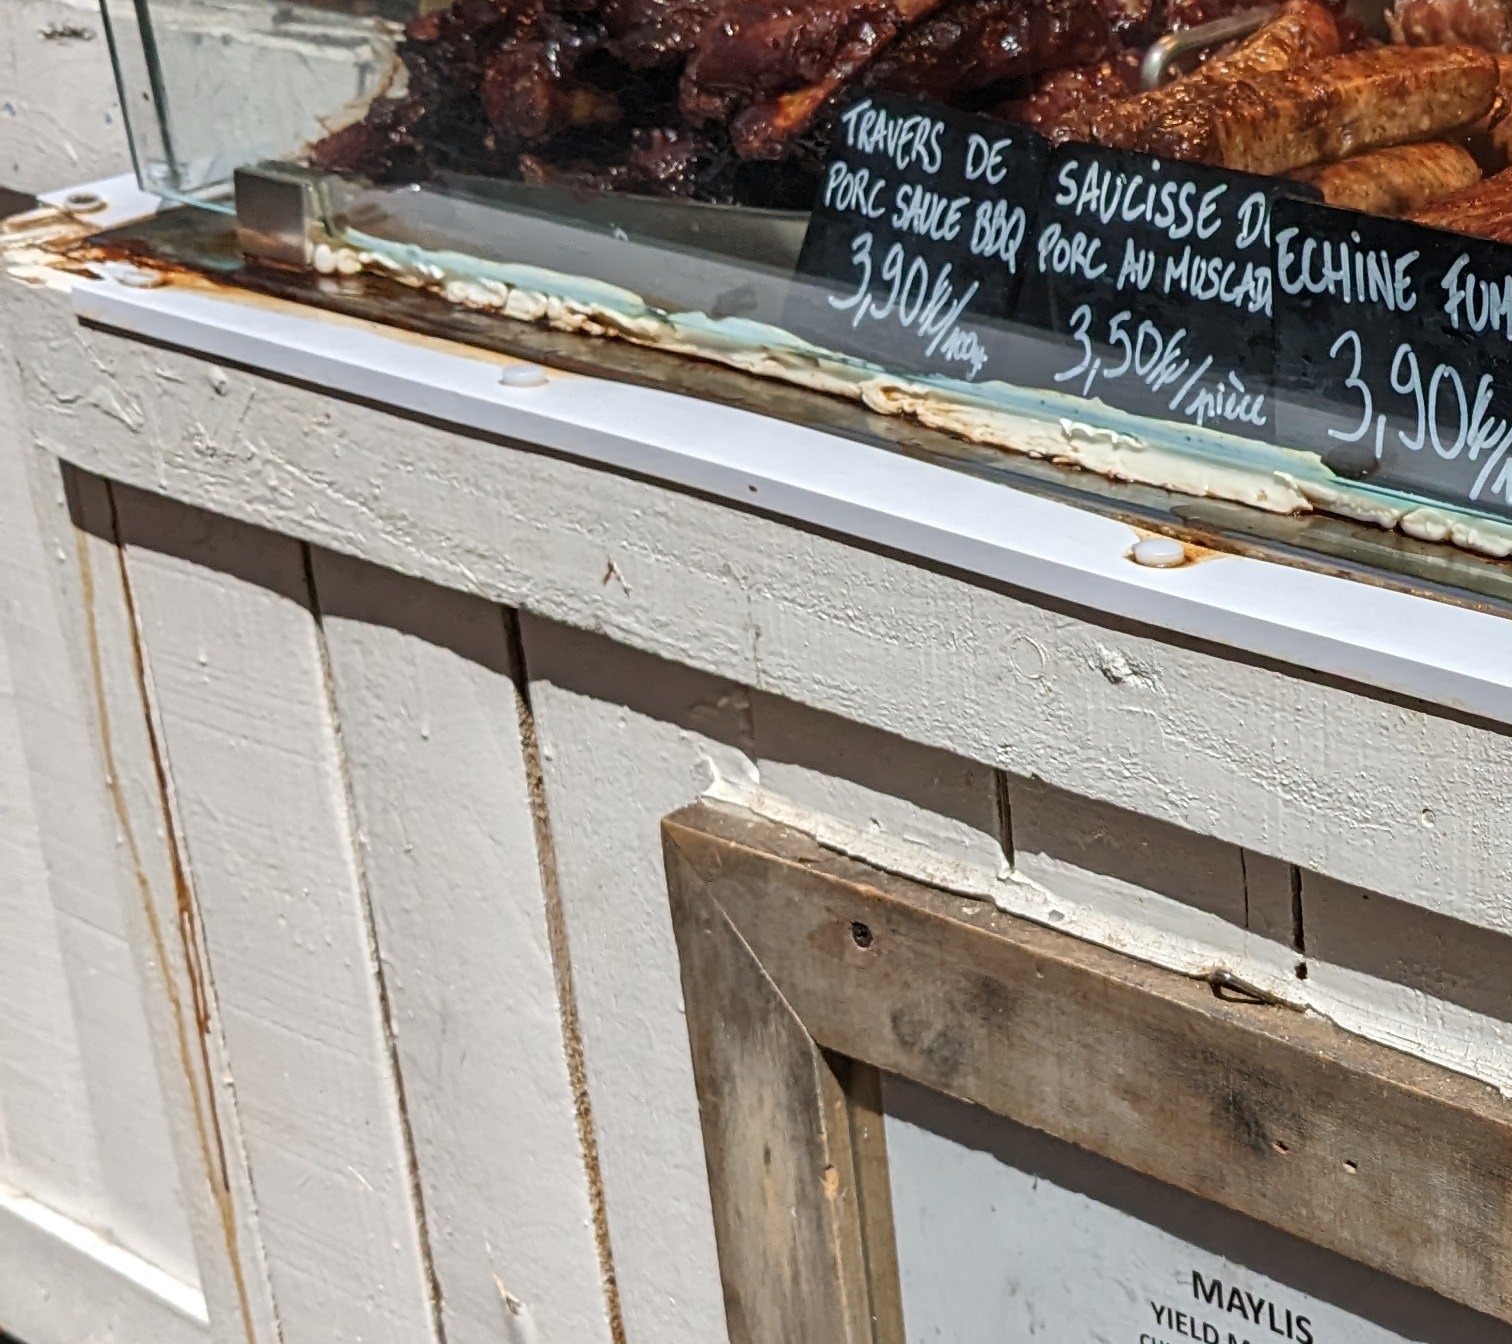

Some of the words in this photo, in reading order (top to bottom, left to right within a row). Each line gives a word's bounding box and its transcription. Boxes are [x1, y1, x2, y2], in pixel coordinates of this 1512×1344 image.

[841, 99, 945, 173] TRAVERS
[966, 135, 1012, 184] DE
[824, 161, 886, 218] PORC
[891, 188, 970, 242] SAUCE
[970, 199, 1026, 273] BBQ
[1055, 159, 1227, 240] SAUCISSE
[1038, 223, 1107, 279] PORC
[1117, 240, 1155, 290] AU
[1164, 246, 1273, 317] MUSCAD
[1275, 226, 1419, 313] ECHINE
